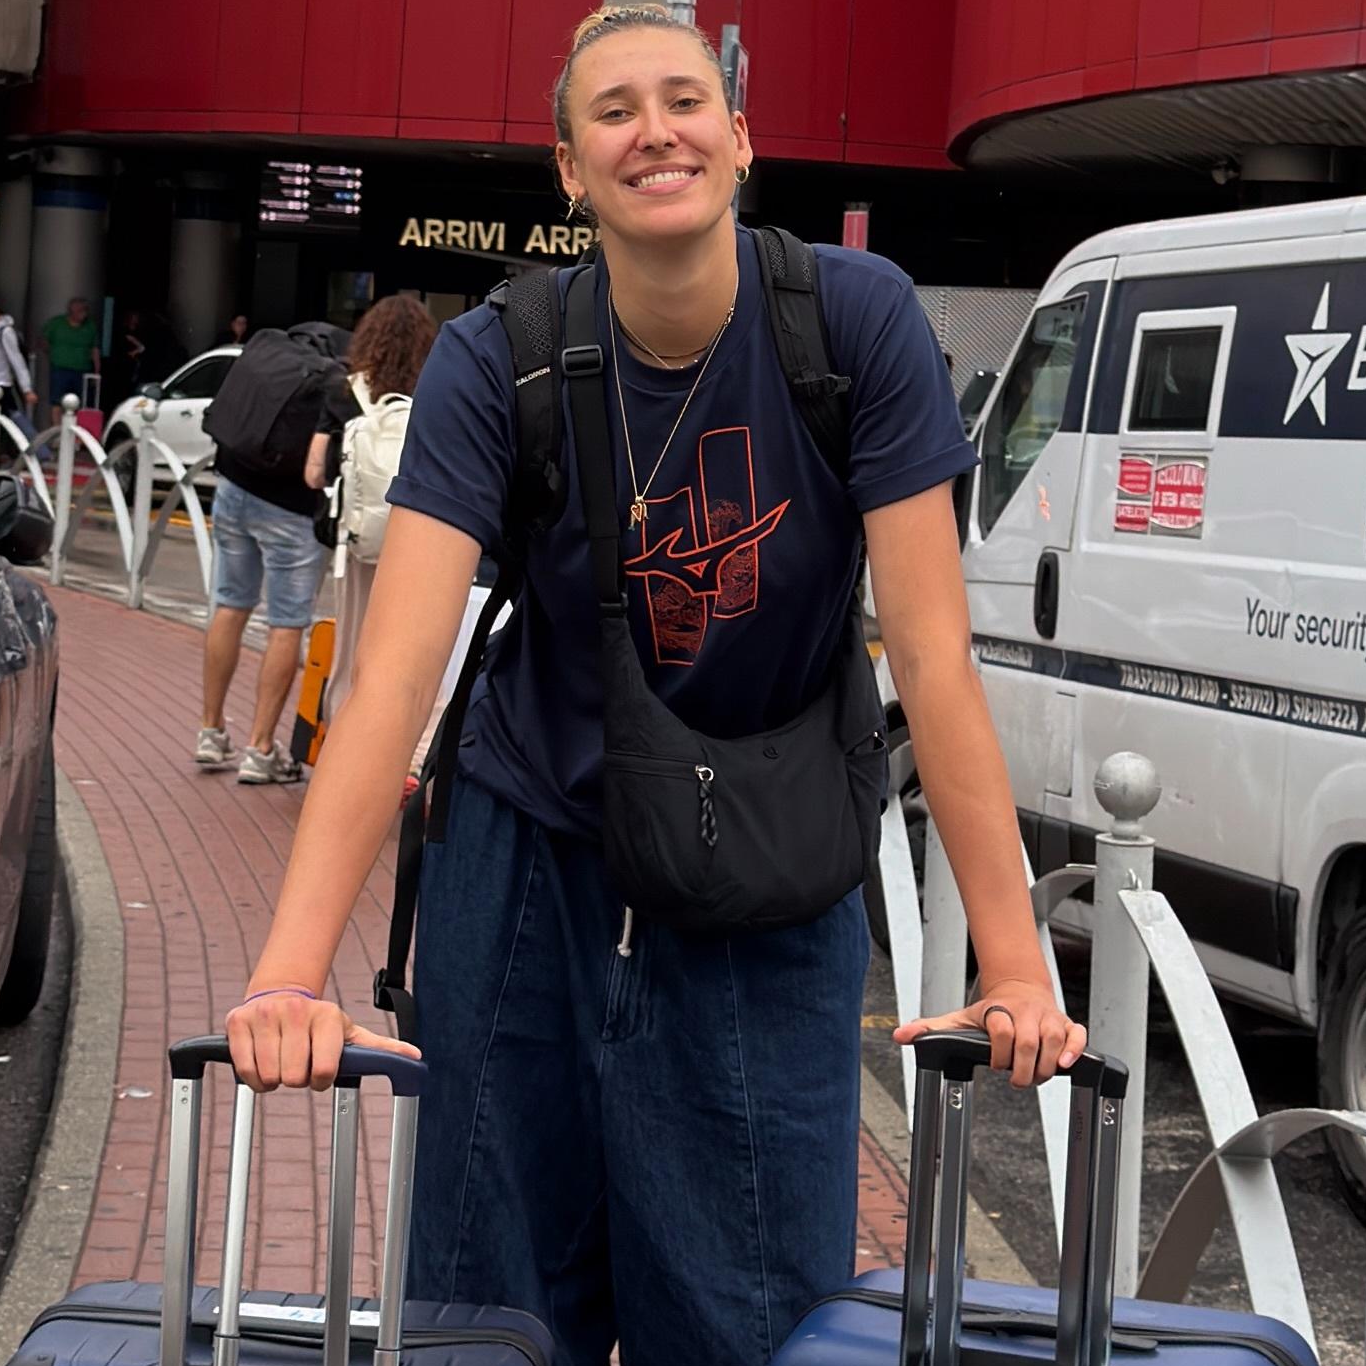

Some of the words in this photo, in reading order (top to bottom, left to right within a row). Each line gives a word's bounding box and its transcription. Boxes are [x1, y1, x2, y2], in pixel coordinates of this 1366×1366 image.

[399, 218, 505, 251] ARRIVI
[515, 366, 551, 387] SALOMON
[1246, 597, 1290, 639] Your
[1120, 664, 1179, 696] TRASPORTO
[1181, 675, 1220, 704] VALORI
[1230, 683, 1275, 716] SERVIZI
[1275, 693, 1290, 718] DI
[1290, 695, 1358, 732] SICUREZZA
